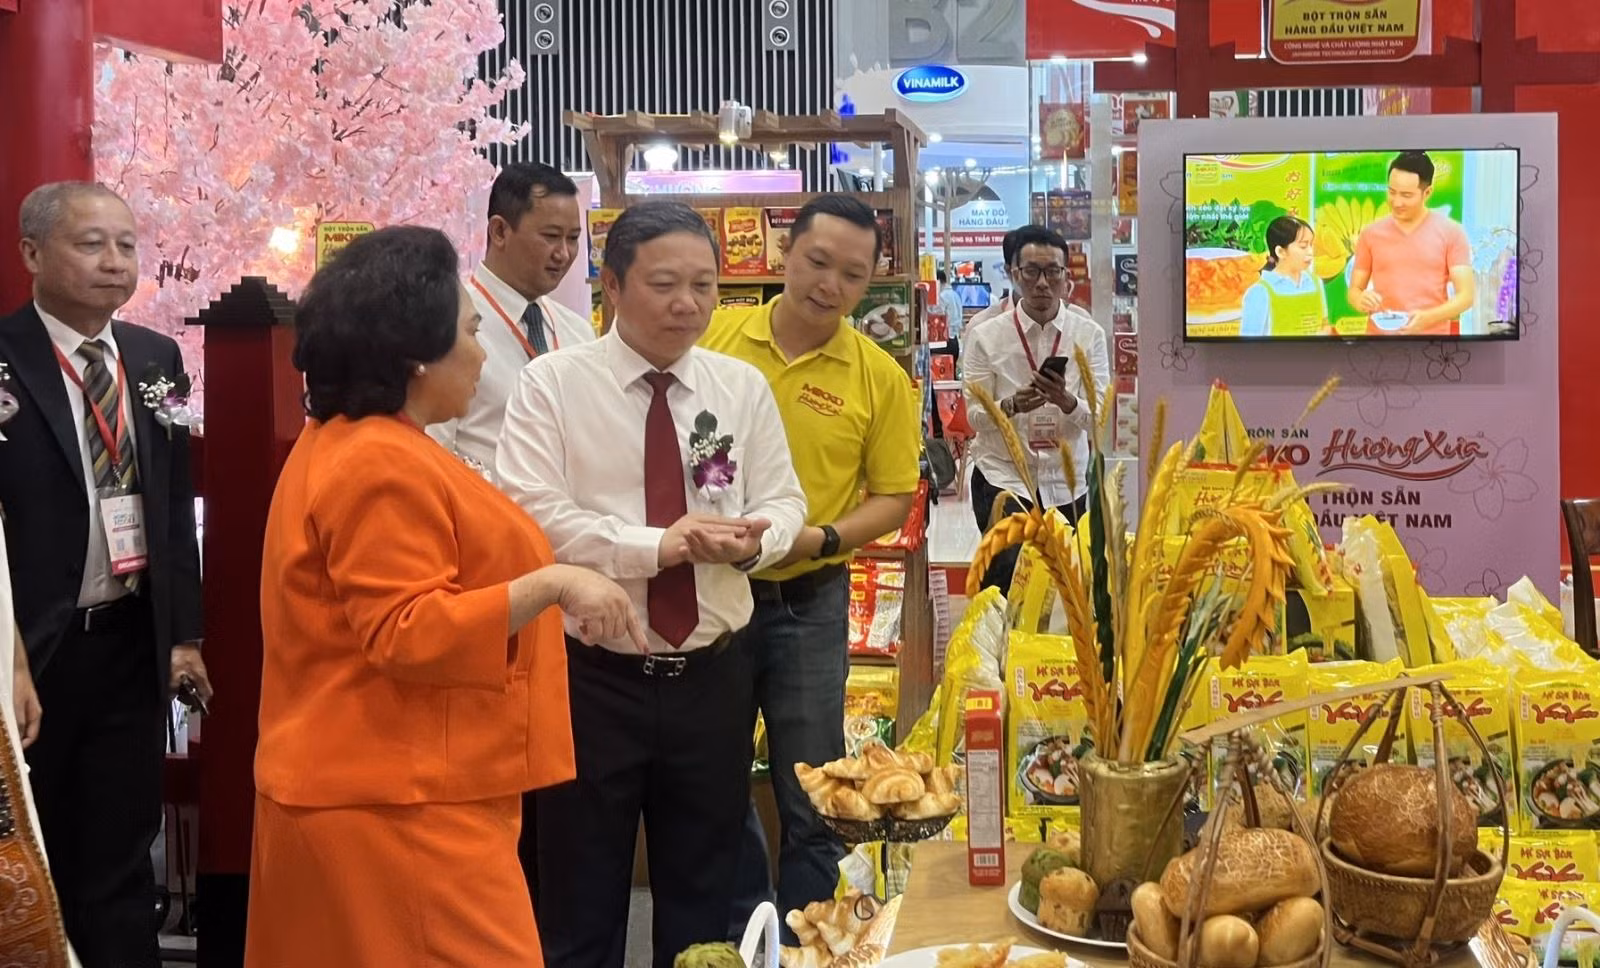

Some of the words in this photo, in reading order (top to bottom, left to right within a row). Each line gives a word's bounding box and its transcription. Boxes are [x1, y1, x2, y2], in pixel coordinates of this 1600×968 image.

[1330, 9, 1360, 21] TRỘN
[1348, 22, 1372, 34] VIỆT
[1378, 24, 1404, 32] NAM
[903, 76, 959, 89] VINAMILK
[1322, 486, 1373, 507] TRỘN
[1406, 514, 1451, 528] NAM
